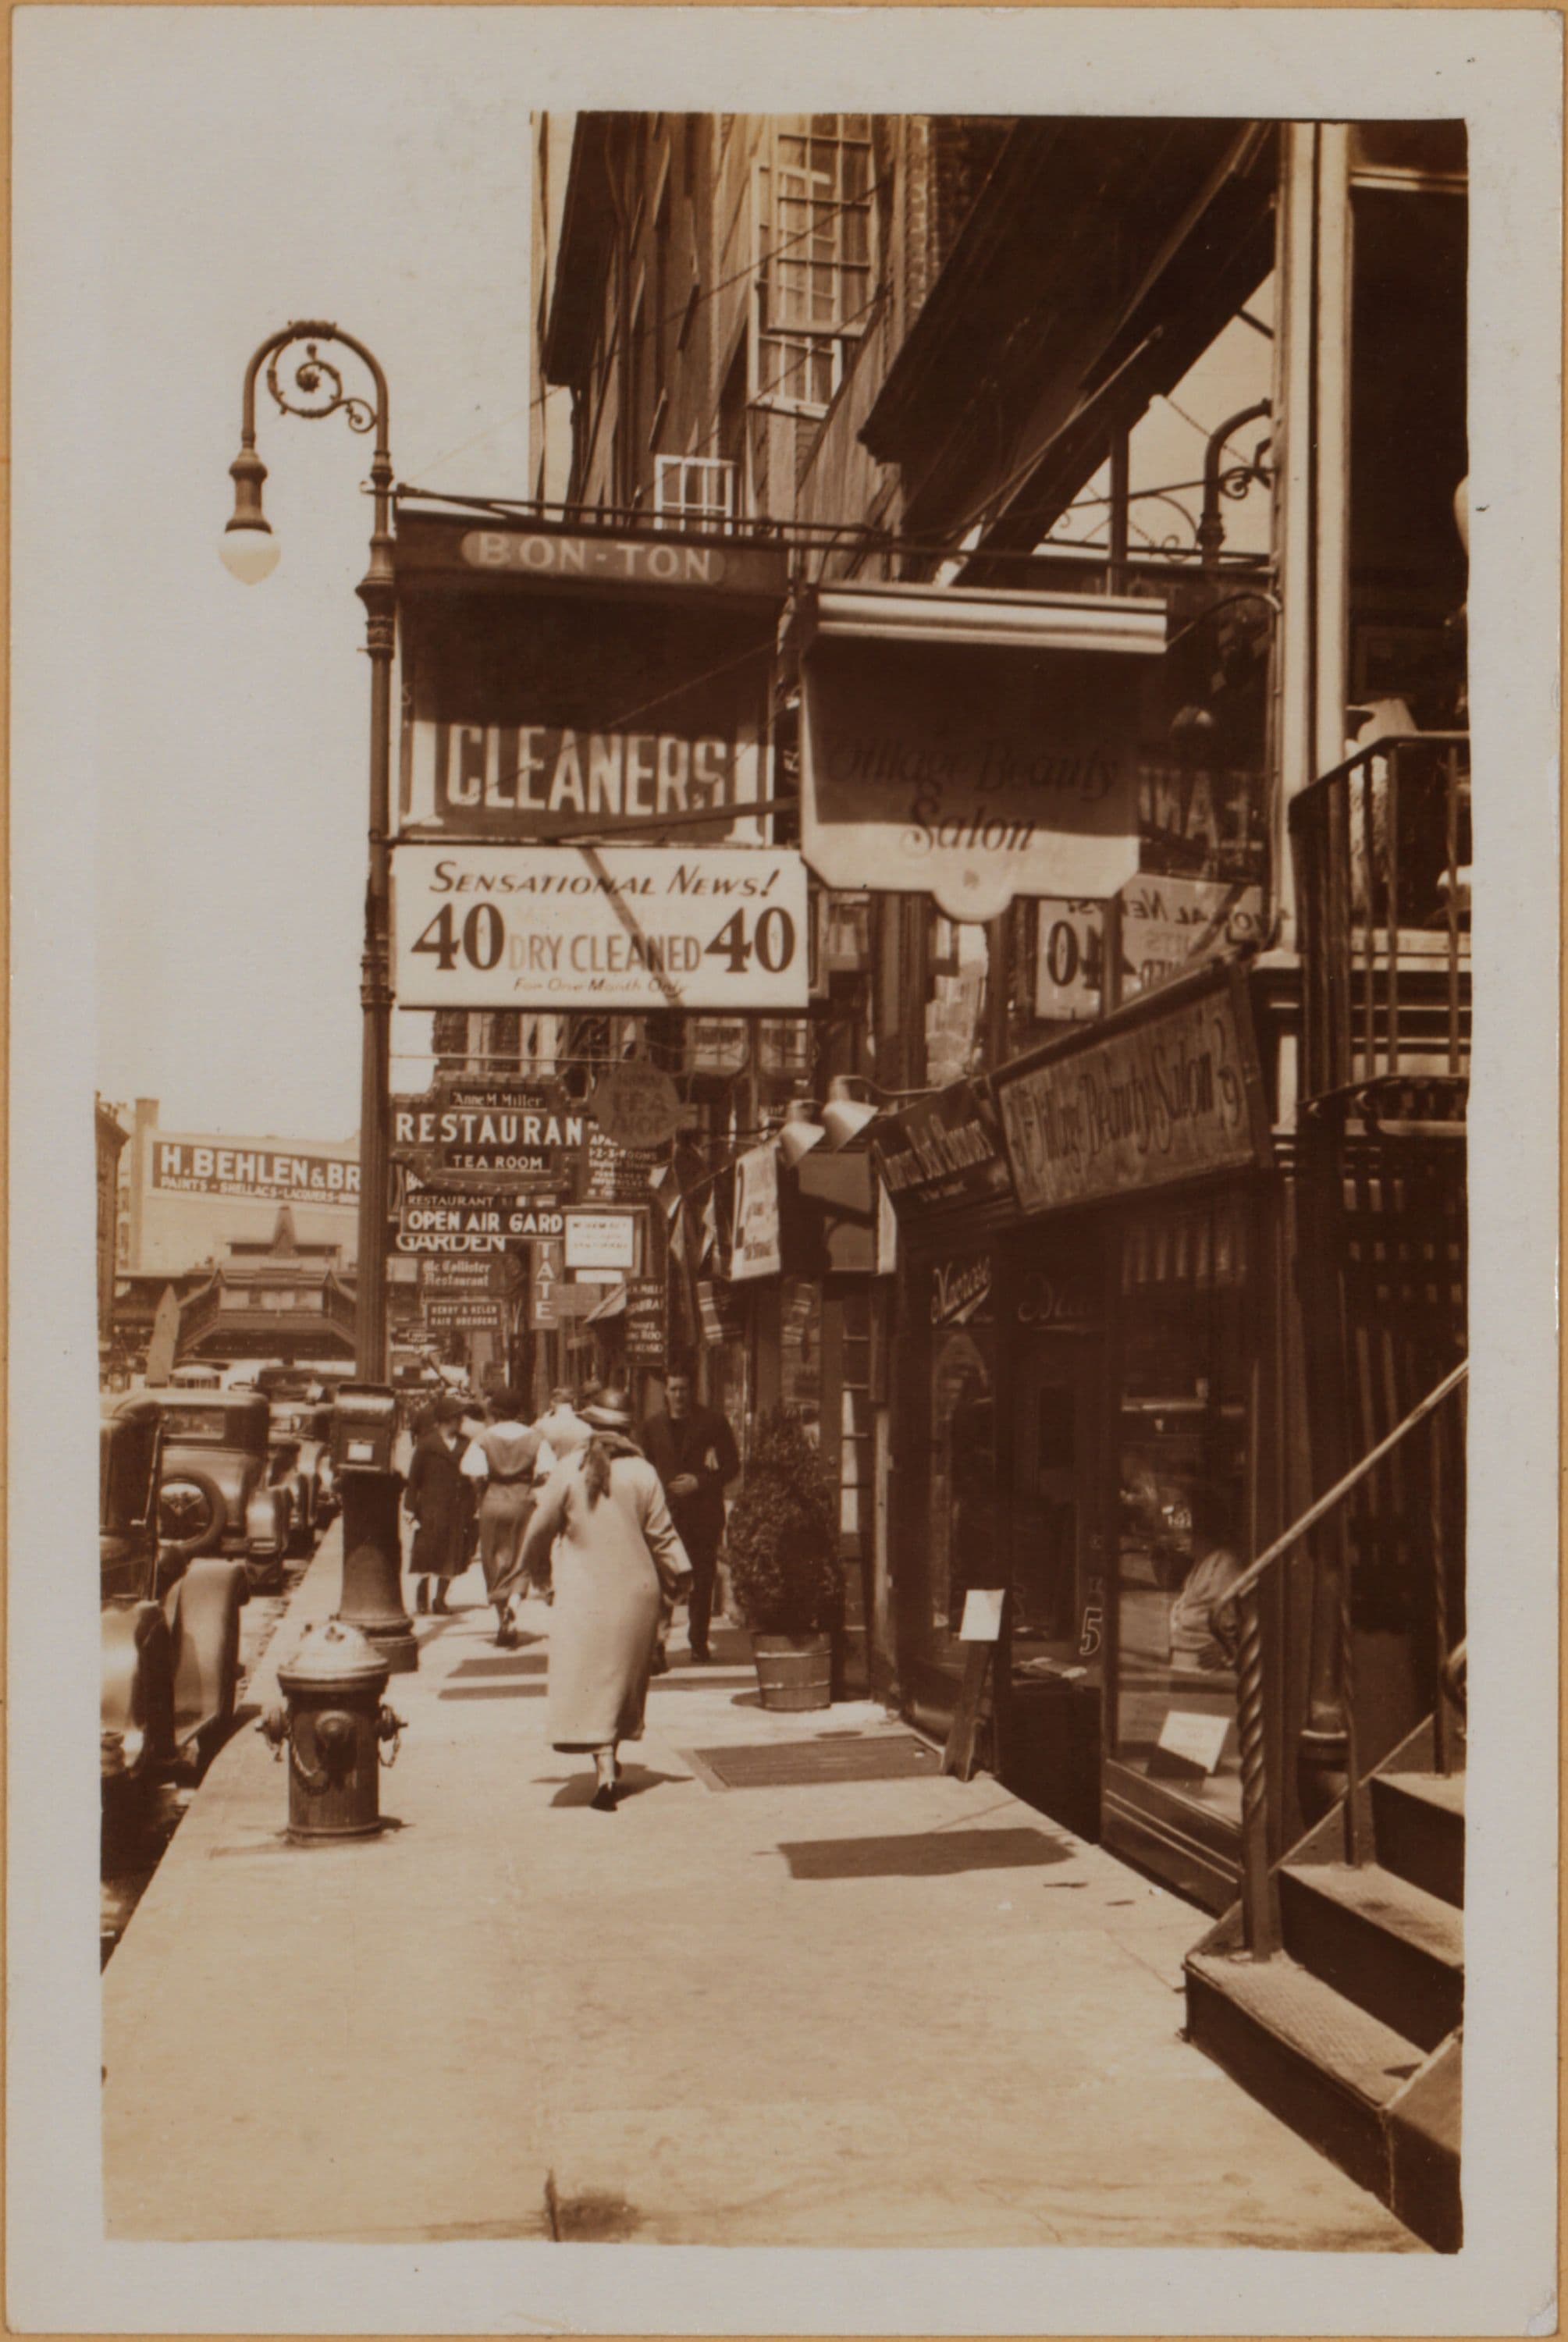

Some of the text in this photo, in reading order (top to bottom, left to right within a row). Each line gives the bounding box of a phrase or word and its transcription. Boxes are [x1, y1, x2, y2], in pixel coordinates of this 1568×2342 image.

[446, 723, 727, 816] CLEANERS
[898, 799, 1036, 857] Salon
[667, 864, 780, 897] NEWS!
[411, 902, 506, 971] 40
[509, 935, 563, 971] DRY
[570, 934, 702, 972] CLEANED
[704, 906, 796, 974] 40
[547, 978, 584, 992] One
[588, 979, 642, 993] Month
[501, 1093, 544, 1108] Miller
[396, 1112, 583, 1147] RESTAURAN
[453, 1154, 543, 1170] TEA ROOM
[408, 1196, 494, 1206] RESTAURANT
[407, 1210, 563, 1233] OPEN AIR GARD
[396, 1234, 506, 1251] GARDEN
[424, 1273, 489, 1286] Restaurant
[1079, 1606, 1103, 1655] 5
